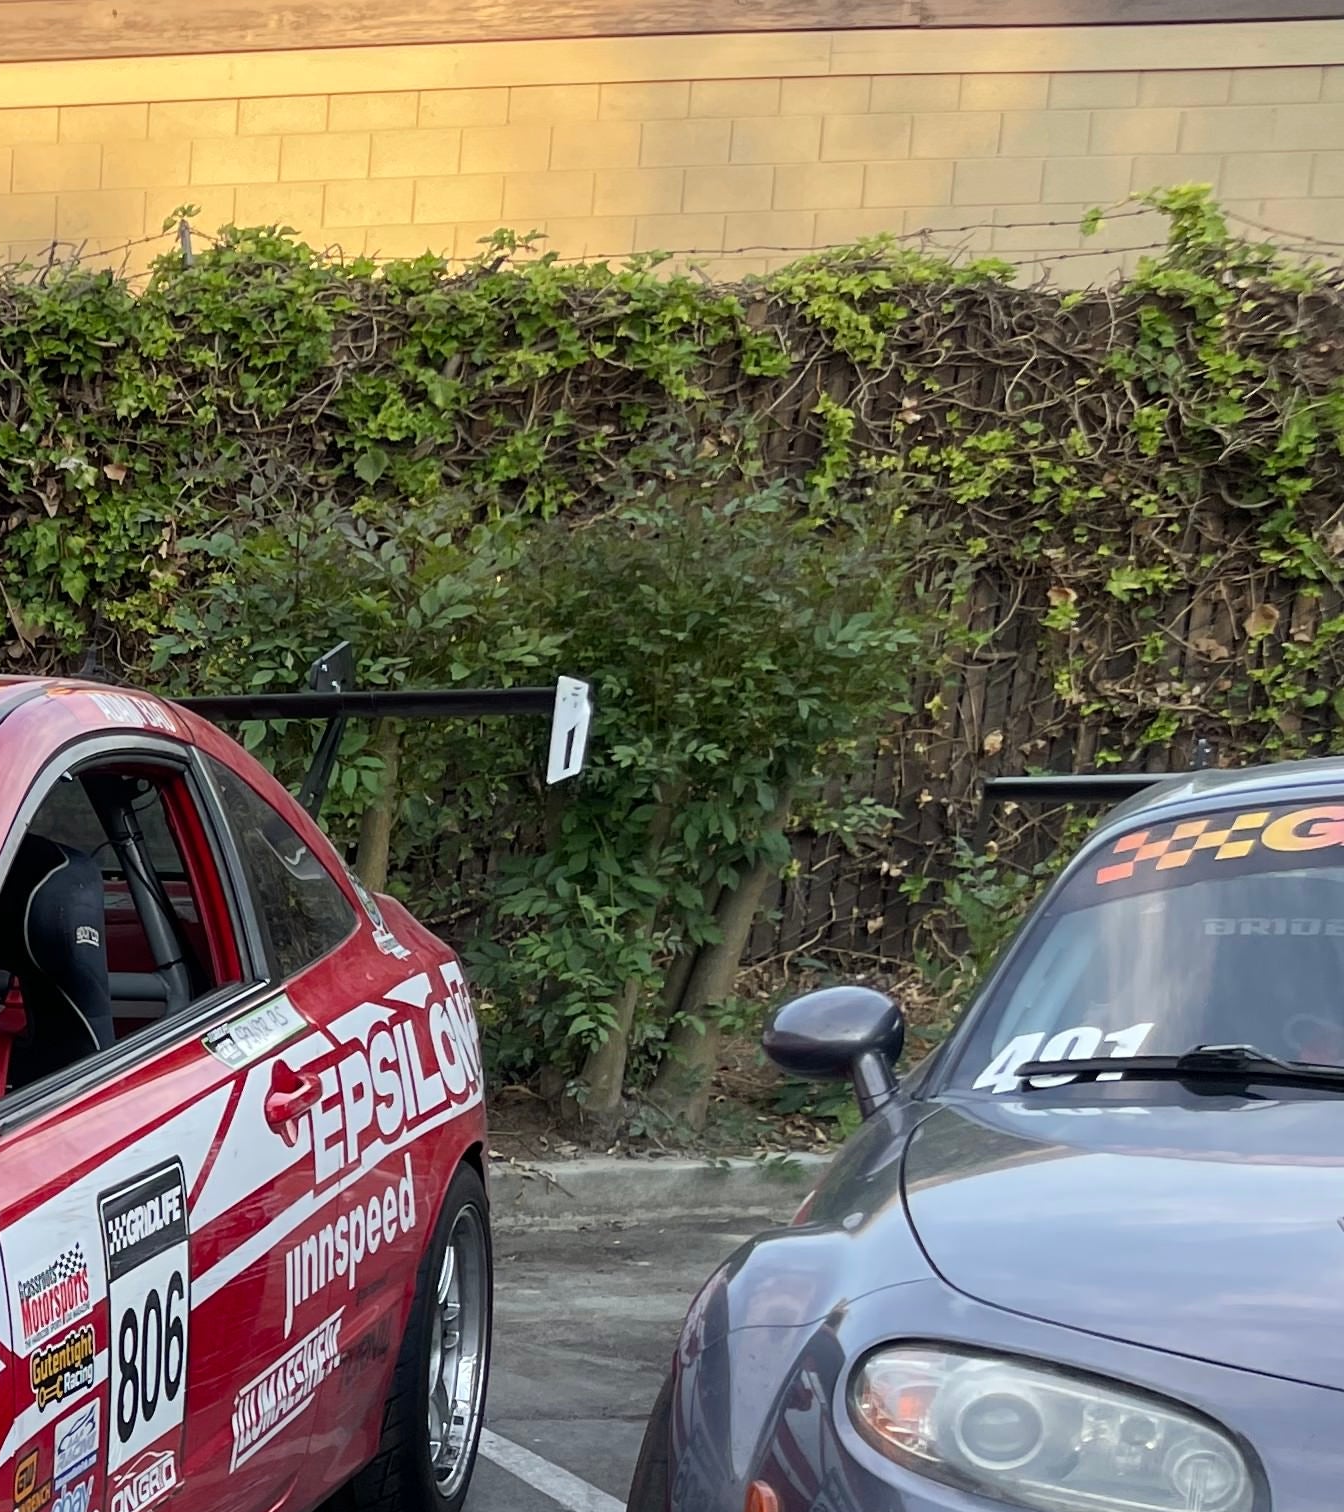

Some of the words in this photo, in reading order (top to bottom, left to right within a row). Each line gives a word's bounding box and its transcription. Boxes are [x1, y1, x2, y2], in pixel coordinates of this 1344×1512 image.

[972, 1023, 1155, 1094] 401
[126, 1185, 182, 1246] GRIDLIFE
[21, 1267, 89, 1339] Motorsports
[32, 1331, 94, 1383] Gutentight
[64, 1363, 94, 1393] Racing
[117, 1270, 184, 1443] 806
